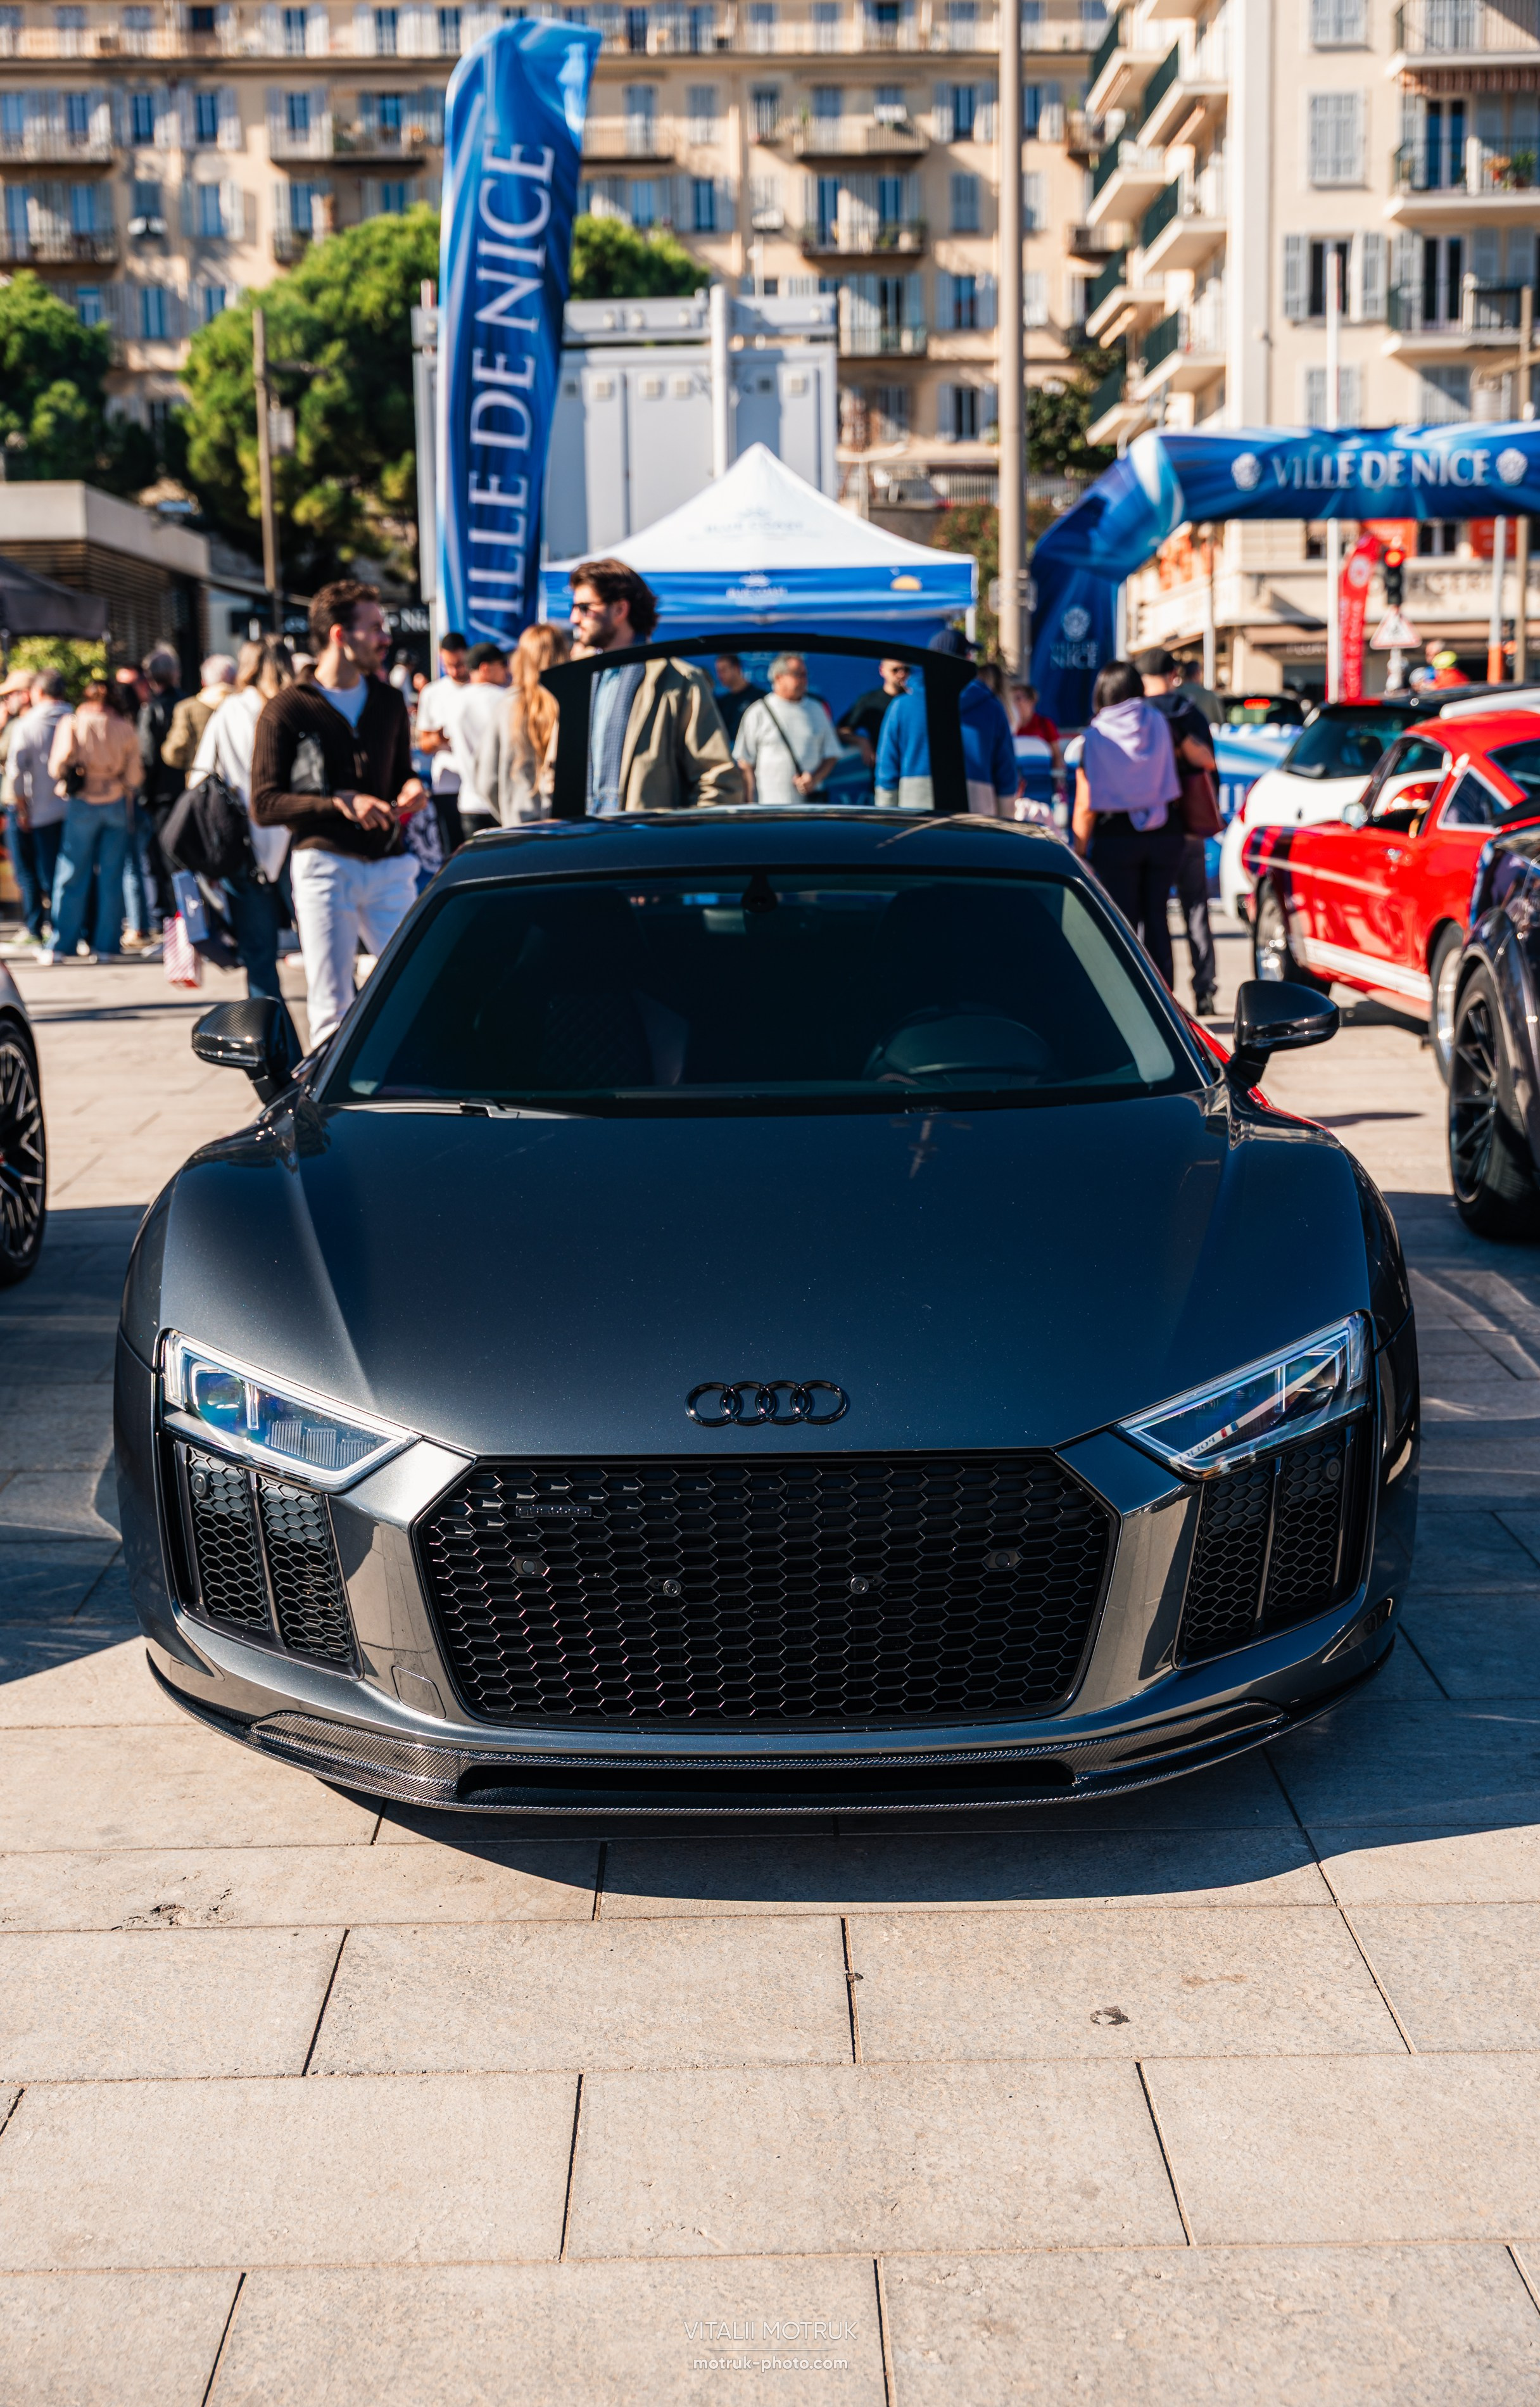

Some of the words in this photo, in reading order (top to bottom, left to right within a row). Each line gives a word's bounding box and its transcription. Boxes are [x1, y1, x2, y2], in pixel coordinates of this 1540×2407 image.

[474, 137, 555, 333] NICE
[470, 348, 537, 452] DE
[1272, 450, 1356, 490] VILLE
[1361, 450, 1407, 488] DE
[1411, 449, 1492, 487] NICE
[467, 471, 528, 652] VILLE
[1050, 652, 1099, 670] NICE
